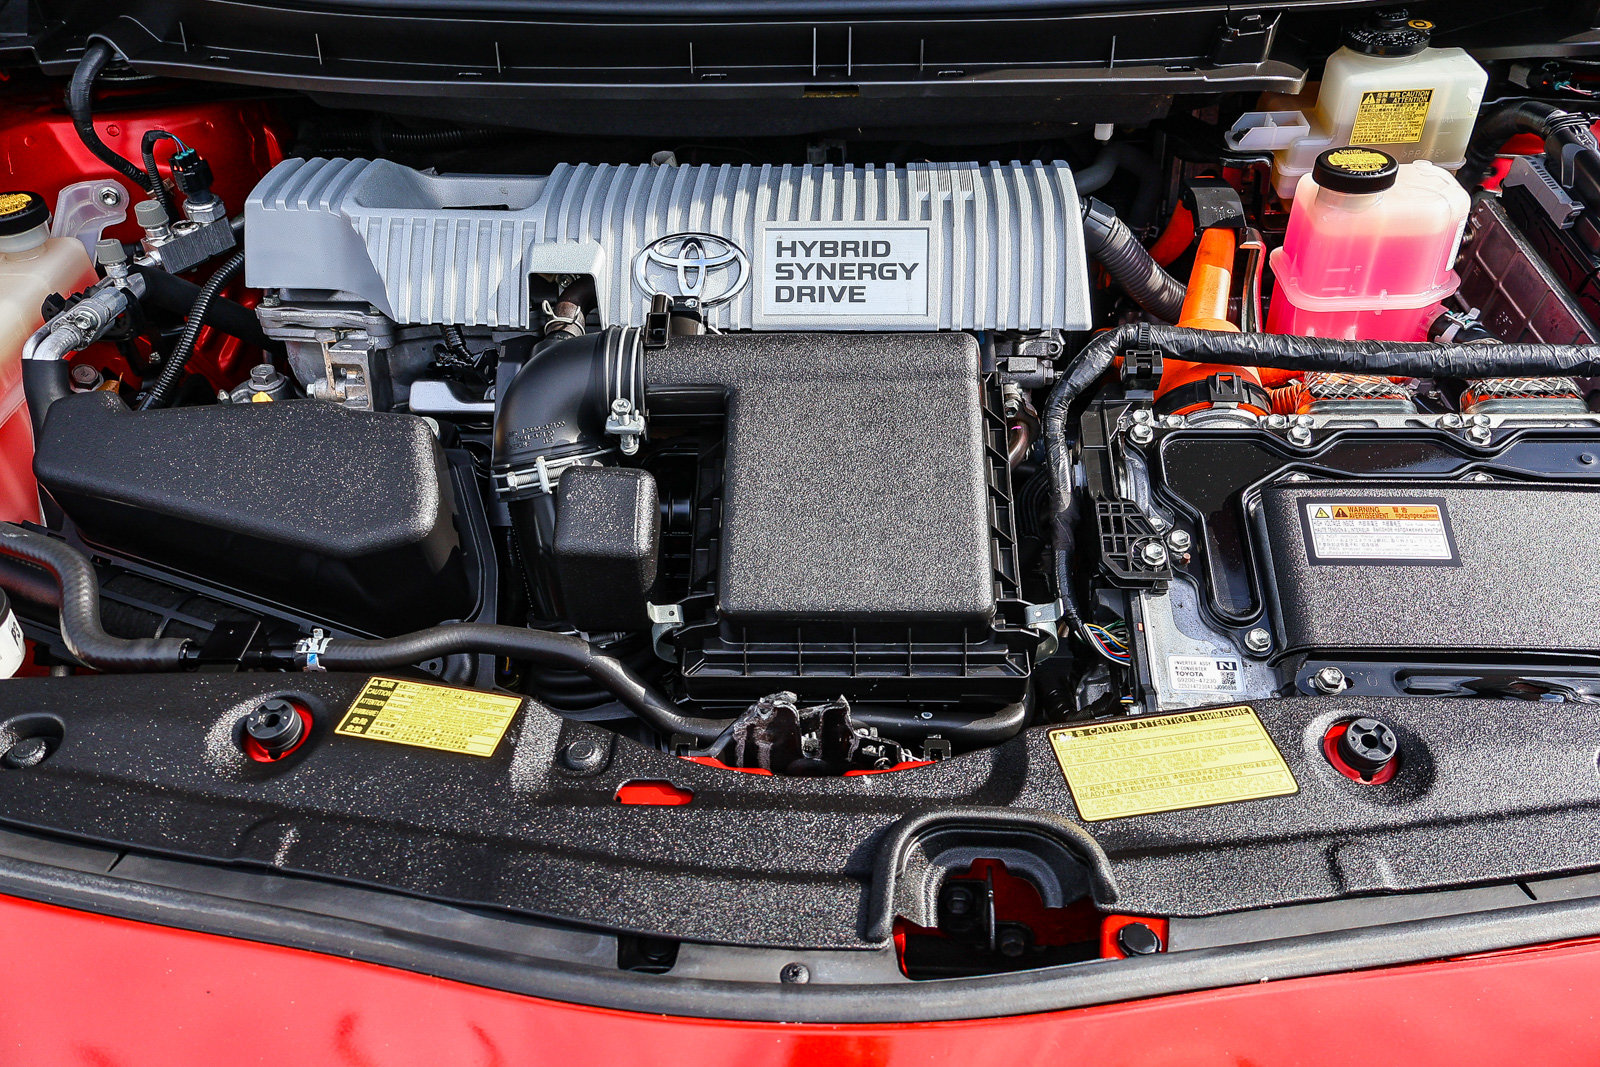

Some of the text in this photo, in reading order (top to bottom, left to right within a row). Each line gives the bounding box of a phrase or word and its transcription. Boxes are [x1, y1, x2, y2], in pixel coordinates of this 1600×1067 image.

[776, 240, 891, 257] HYBRID
[775, 262, 920, 281] SYNERGY
[1354, 265, 1363, 274] F
[775, 285, 867, 303] DRIVE
[366, 687, 393, 697] CAUTION
[360, 697, 387, 707] ATTENTION
[1195, 708, 1249, 721] ВНИМАНИЕ
[1088, 722, 1133, 735] CAUTION
[1137, 714, 1192, 730] ATTENTION
